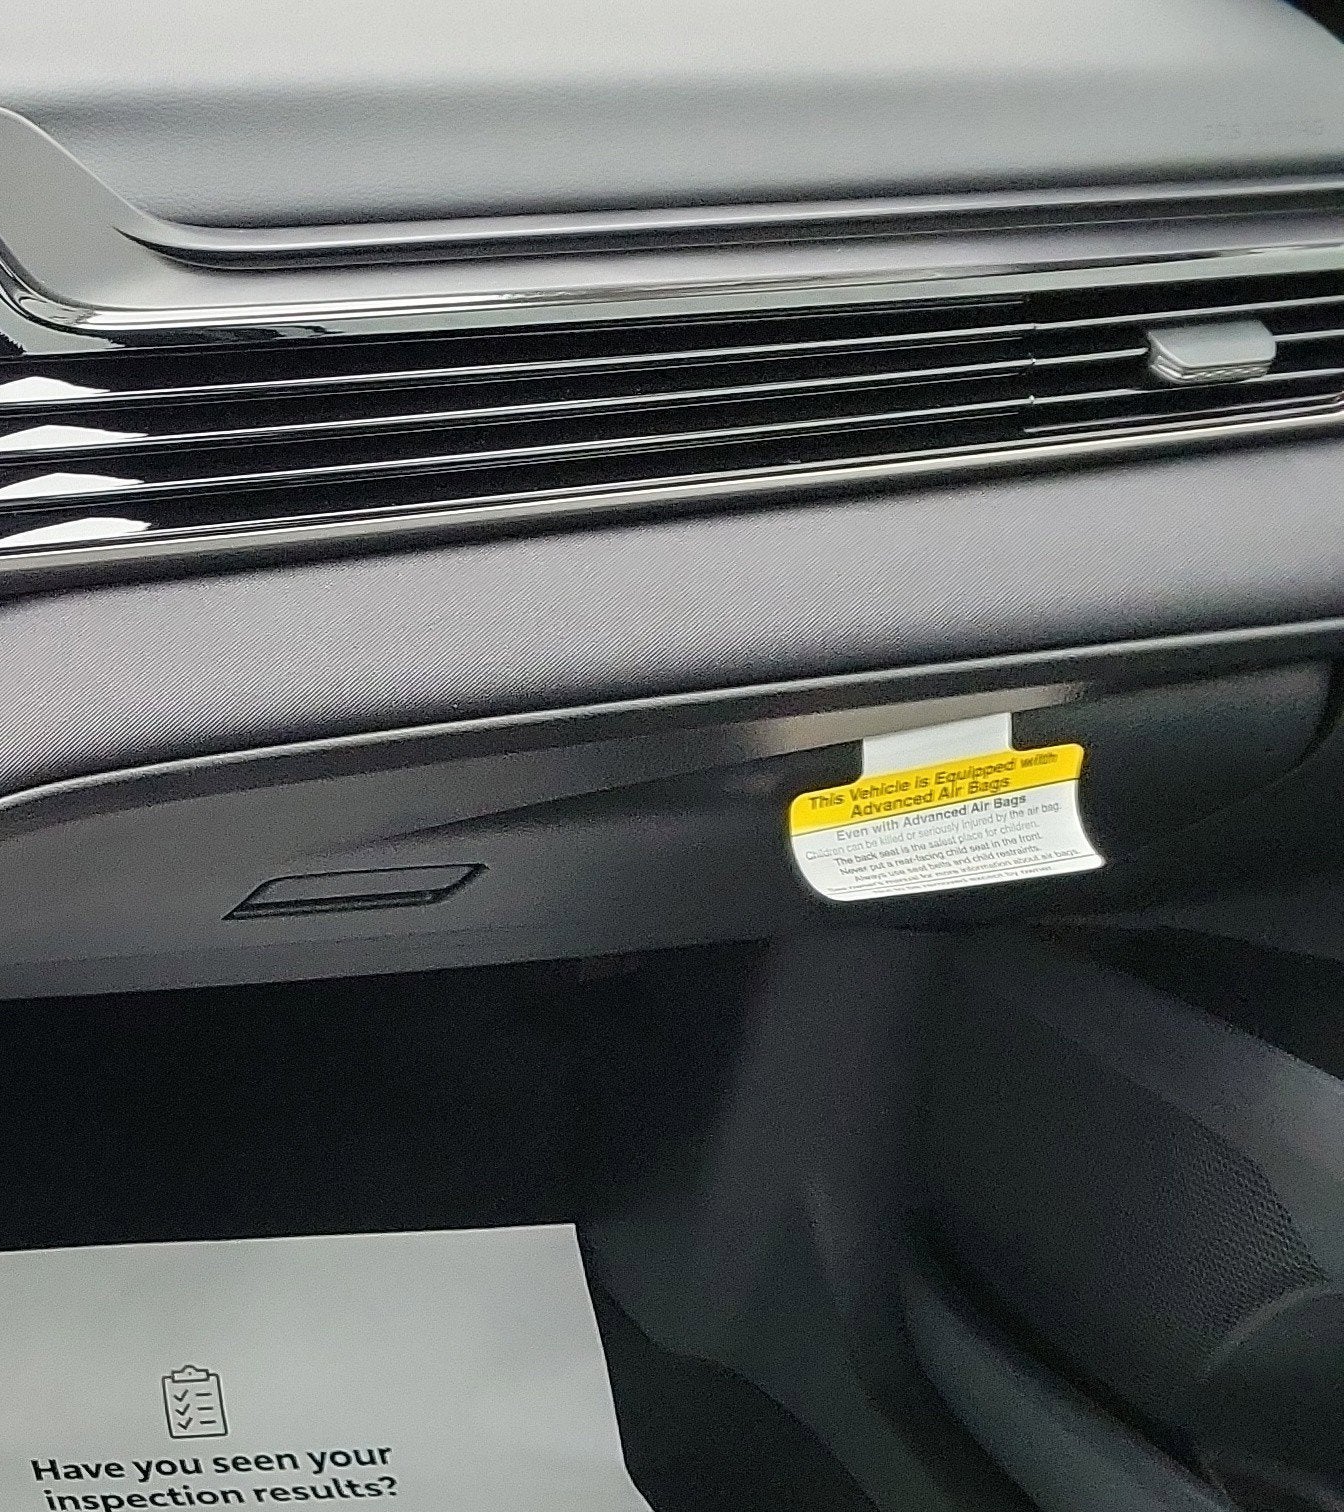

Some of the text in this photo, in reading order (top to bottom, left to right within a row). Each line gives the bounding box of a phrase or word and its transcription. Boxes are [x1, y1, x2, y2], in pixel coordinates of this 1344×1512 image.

[809, 793, 845, 810] This
[850, 780, 911, 801] Vehicle
[935, 758, 1016, 786] Equipped
[851, 778, 1010, 818] Advanced Air Bags
[837, 795, 1026, 841] Even with Advanced Air Bags
[31, 1446, 393, 1483] Have you seen your
[252, 1475, 399, 1503] results?
